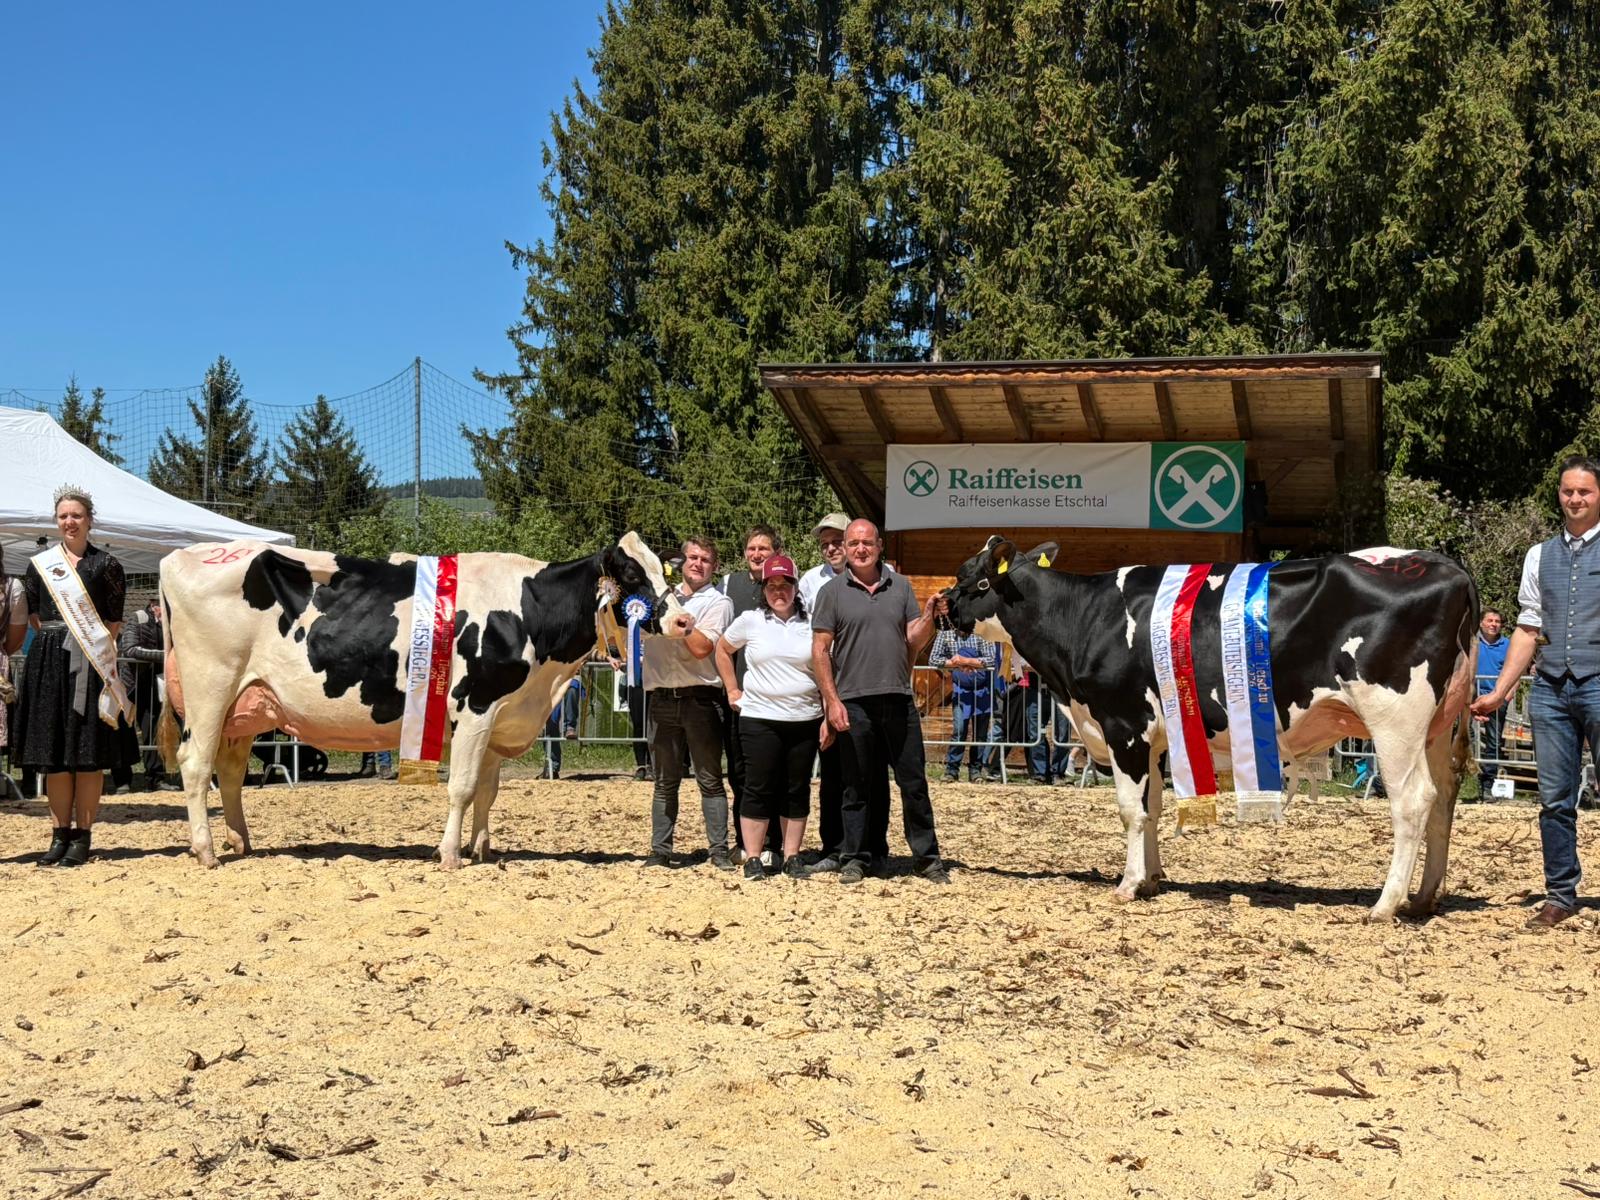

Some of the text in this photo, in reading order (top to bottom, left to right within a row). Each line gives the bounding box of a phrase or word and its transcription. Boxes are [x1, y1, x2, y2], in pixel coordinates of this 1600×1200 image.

[947, 467, 1083, 490] Raiffeisen
[948, 494, 1108, 508] Raiffeisenkasse Etschtal
